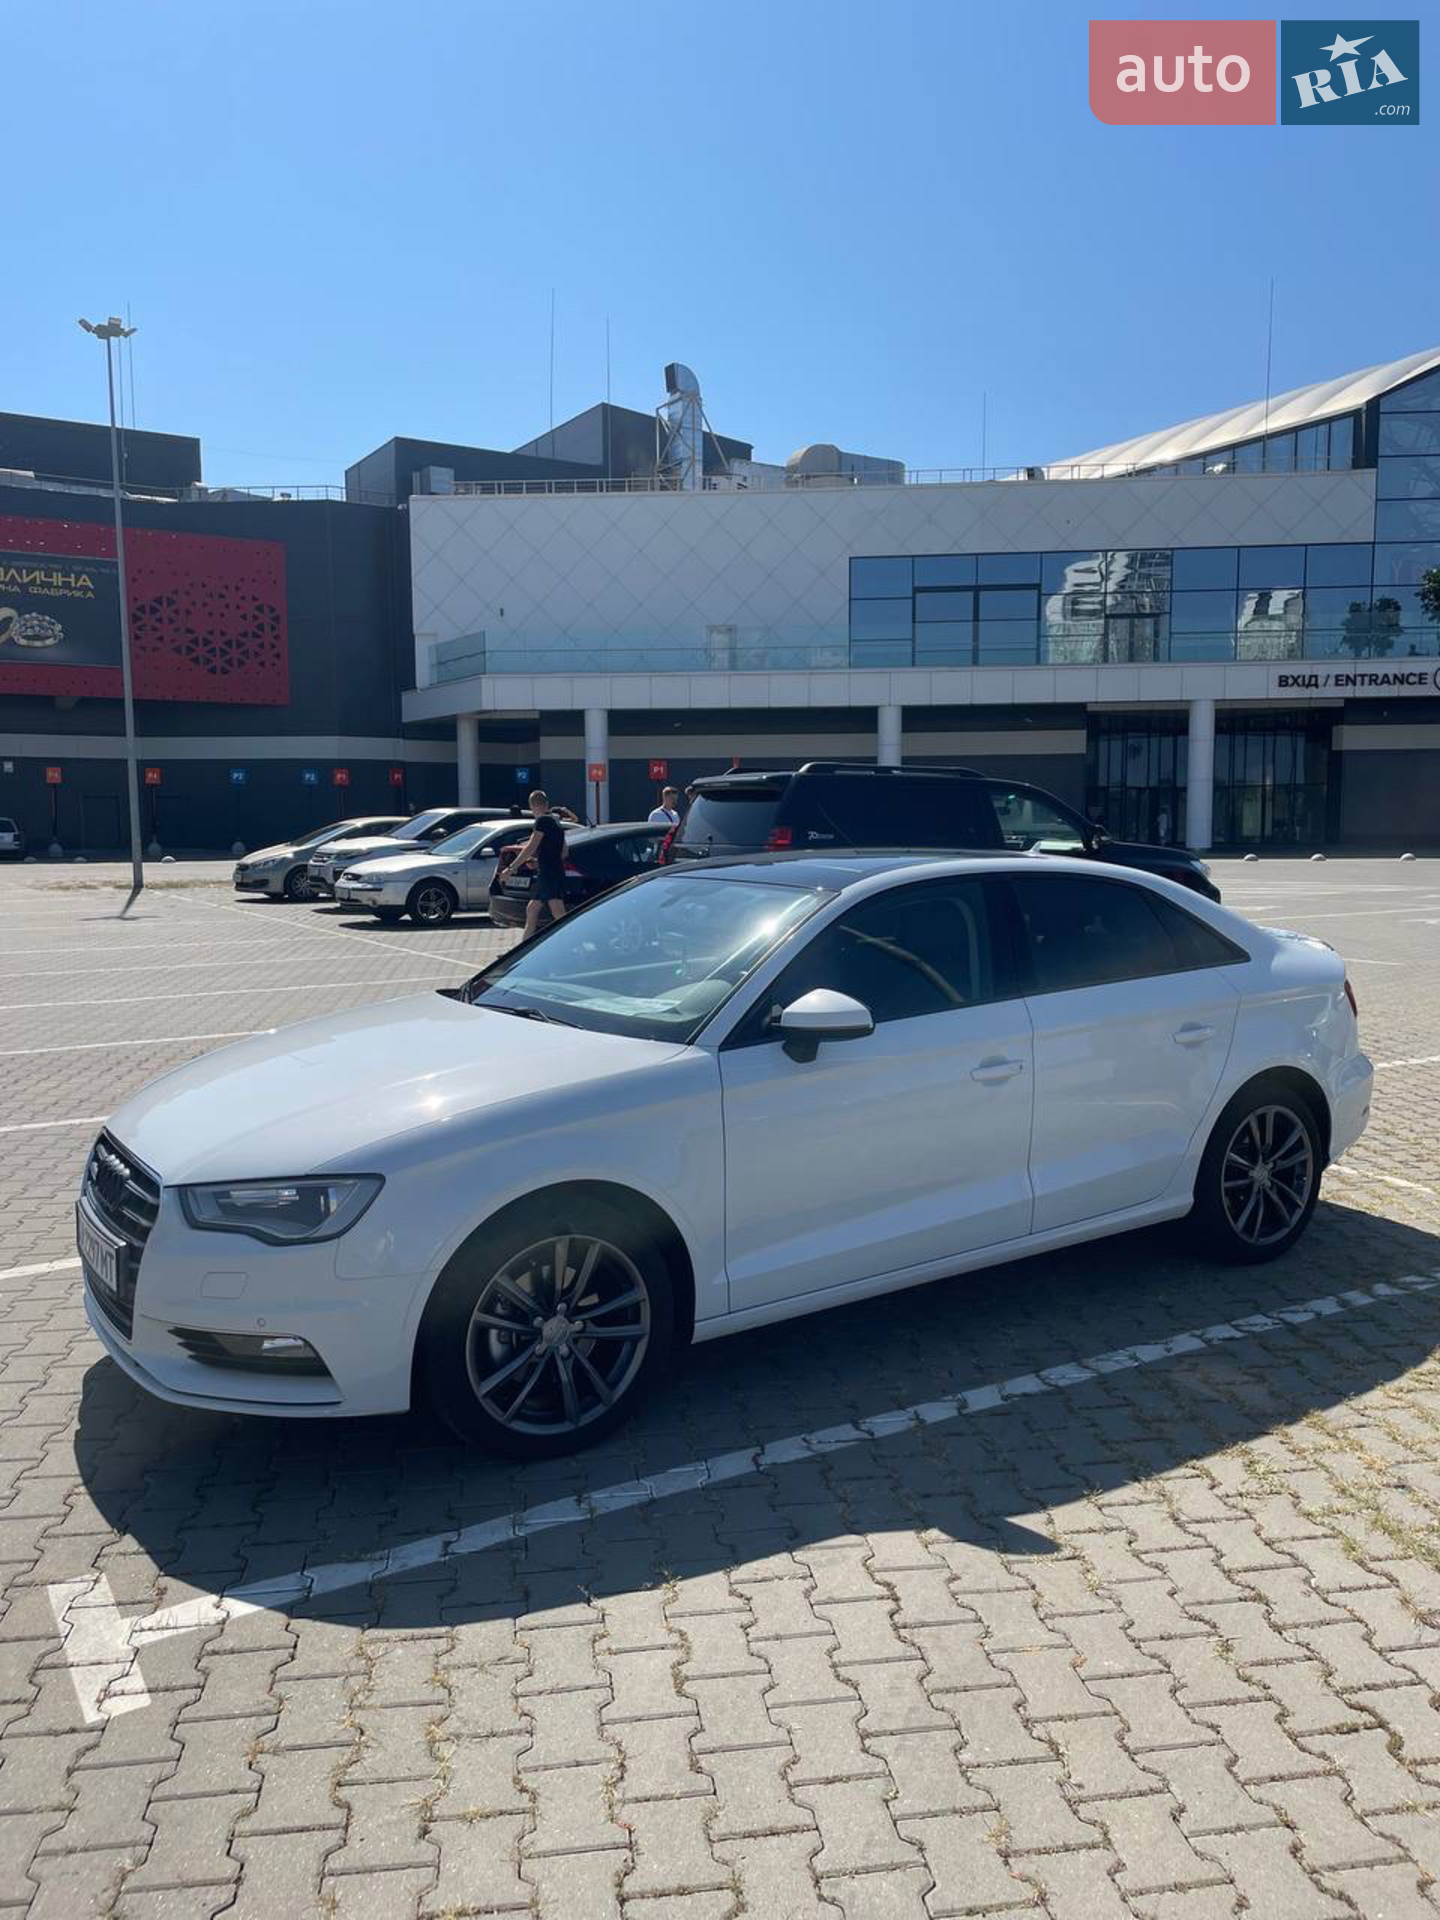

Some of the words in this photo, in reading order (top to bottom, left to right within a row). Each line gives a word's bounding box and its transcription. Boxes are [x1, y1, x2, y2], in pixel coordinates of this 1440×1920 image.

[0, 567, 94, 589] ЛИЧНА
[28, 585, 95, 599] ФАБРИКА
[1278, 674, 1319, 689] ВХІД
[1334, 672, 1428, 687] ENTRANCE
